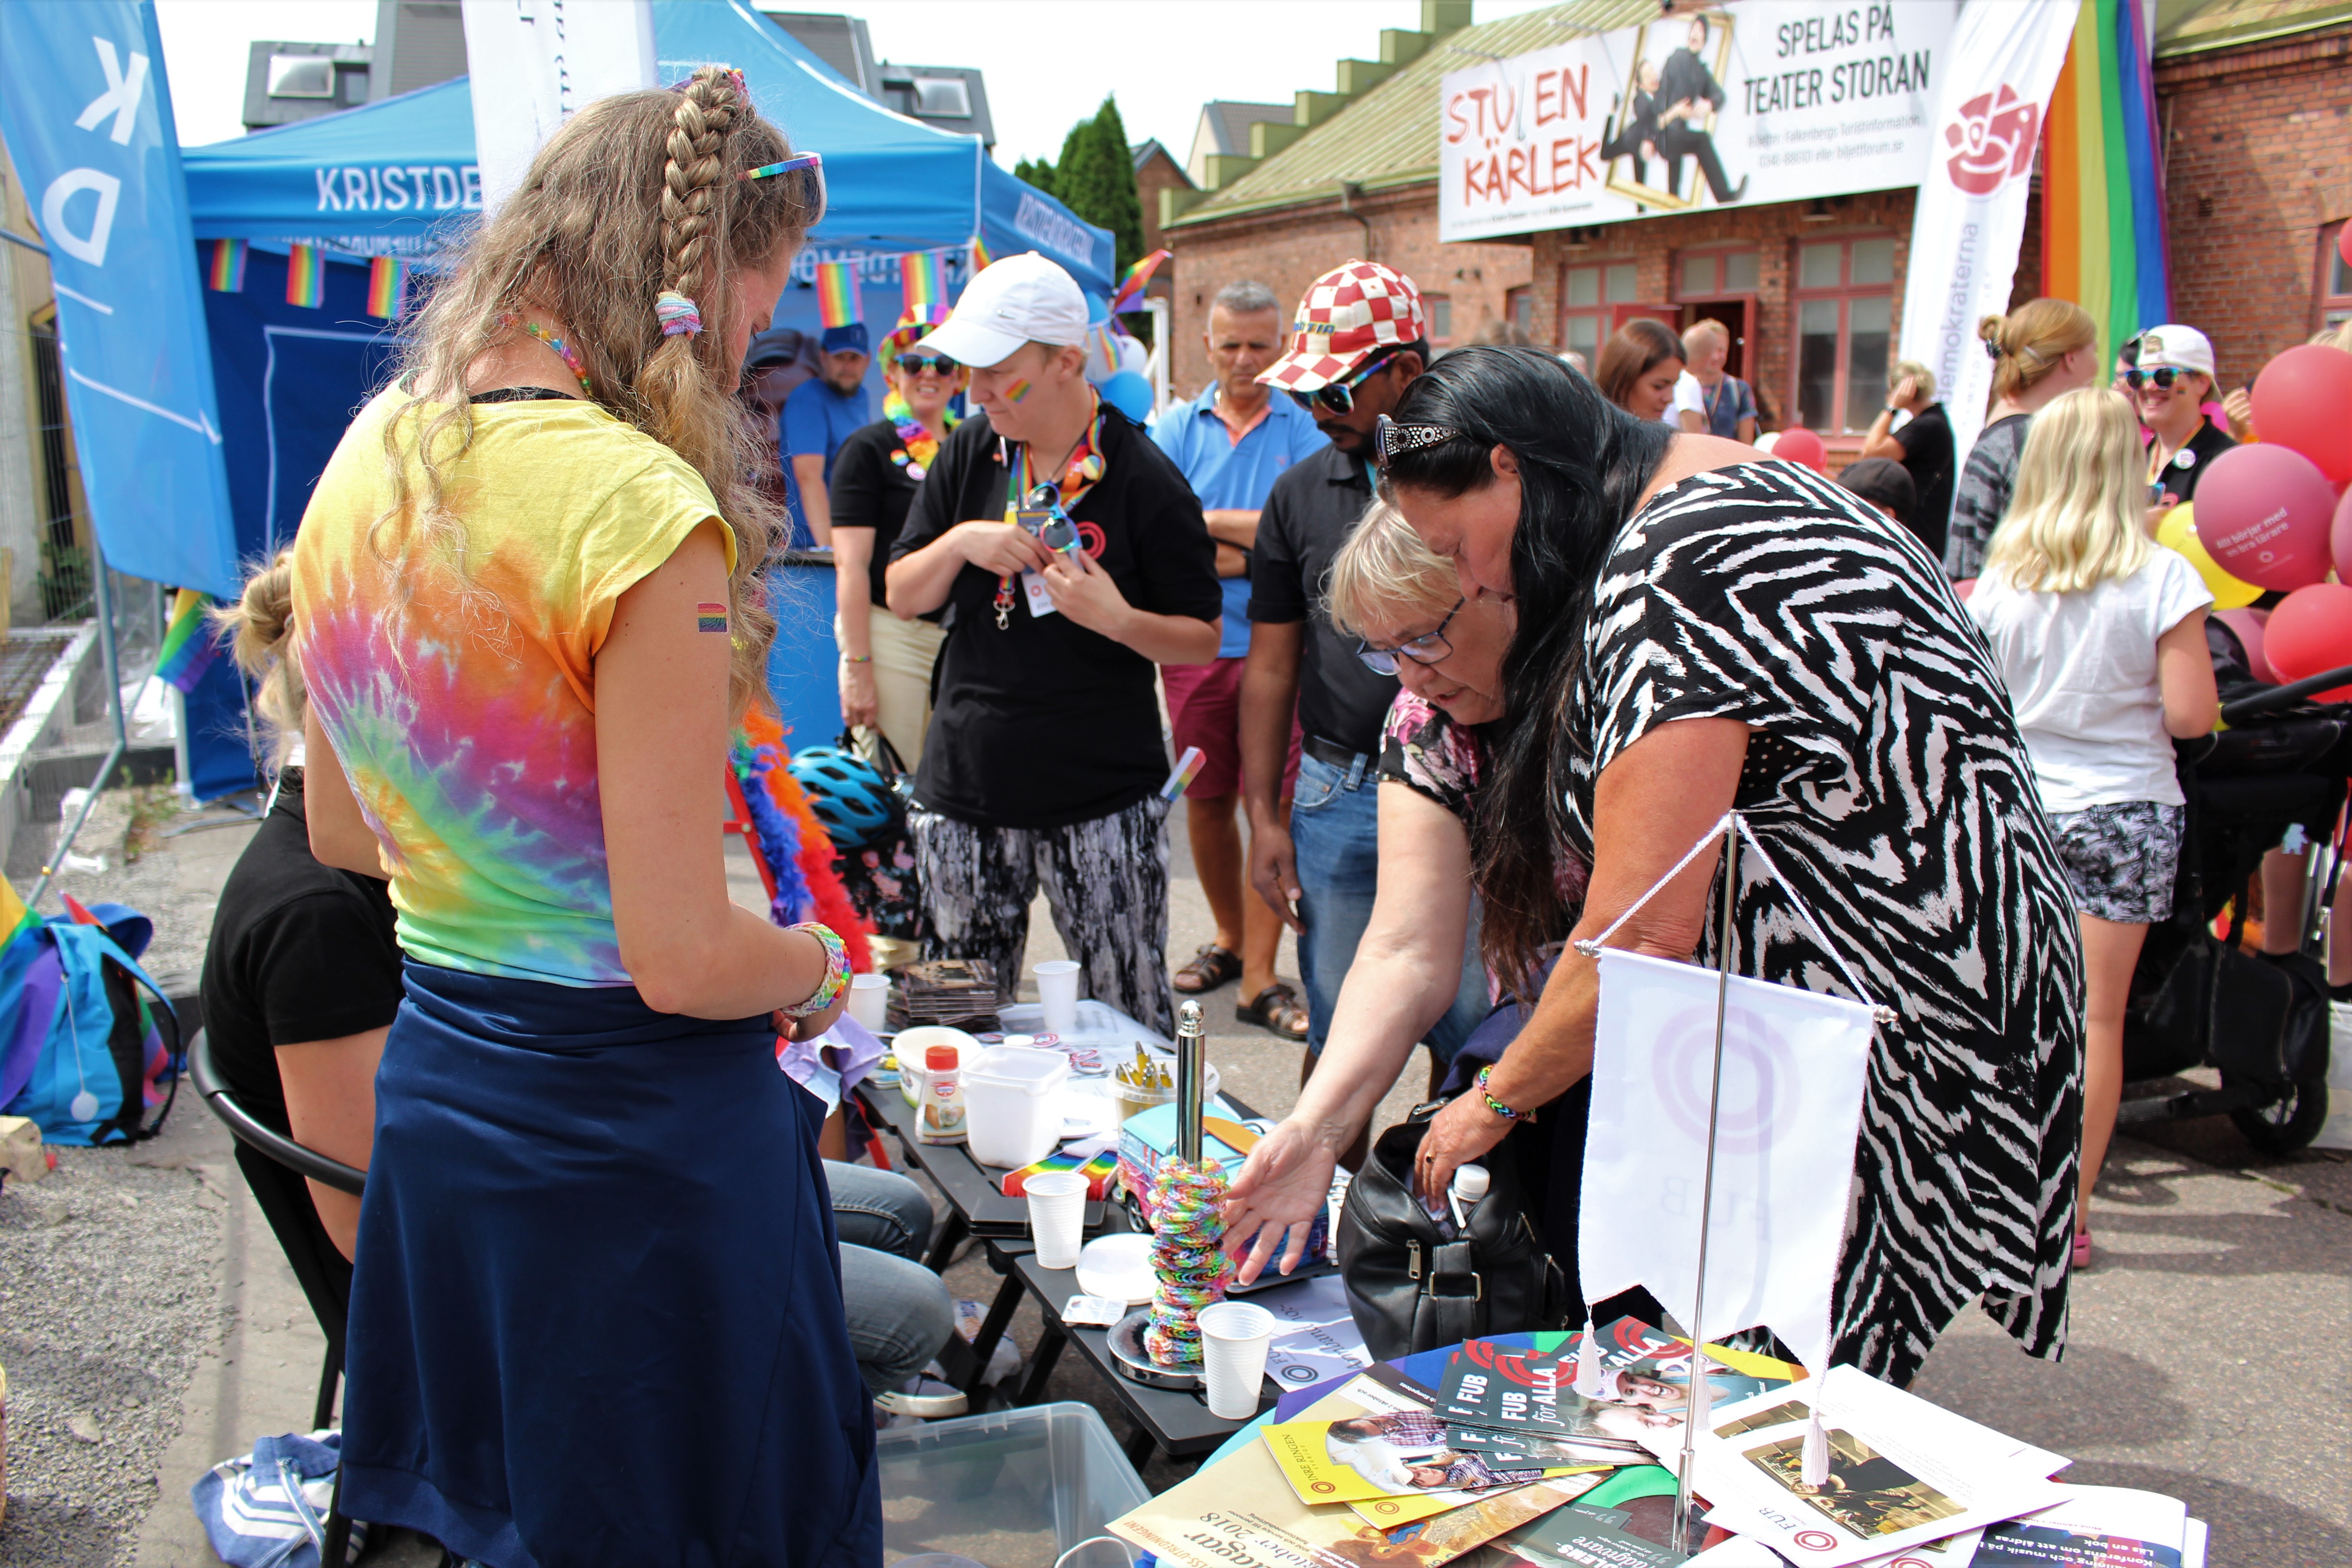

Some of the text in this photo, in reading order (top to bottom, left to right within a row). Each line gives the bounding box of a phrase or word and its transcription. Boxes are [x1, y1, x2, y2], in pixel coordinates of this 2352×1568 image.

[1778, 9, 1860, 58] SPELAS
[1744, 49, 1931, 115] TEATER STORAN
[1842, 114, 1920, 135] Turistinformation
[1464, 135, 1600, 207] KÄRLEK
[2217, 507, 2288, 549] Allt börjar med
[2227, 522, 2289, 558] en bra lärare
[1293, 1324, 1364, 1369] Armband
[1607, 1337, 1667, 1367] ALLA
[1367, 1393, 1388, 1406] oktober
[1456, 1373, 1489, 1403] FUB
[1532, 1368, 1565, 1427] för ALLA
[1501, 1392, 1528, 1421] FUB
[1282, 1434, 1319, 1481] INRE RINGEN
[1300, 1445, 1319, 1470] SVERIGE
[1200, 1512, 1255, 1539] 2018
[1227, 1510, 1253, 1524] personer
[1247, 1513, 1309, 1544] funktionsnedsättning
[1759, 1507, 1797, 1530] FUB
[1262, 1527, 1284, 1540] service
[1988, 1541, 2004, 1551] på
[1995, 1535, 2035, 1548] åldras
[2083, 1539, 2108, 1549] bok
[1294, 1544, 1310, 1552] stöd
[2007, 1547, 2046, 1558] musik
[2050, 1553, 2073, 1563] och
[2084, 1549, 2152, 1568] Konferens
[2132, 1547, 2154, 1557] Läs
